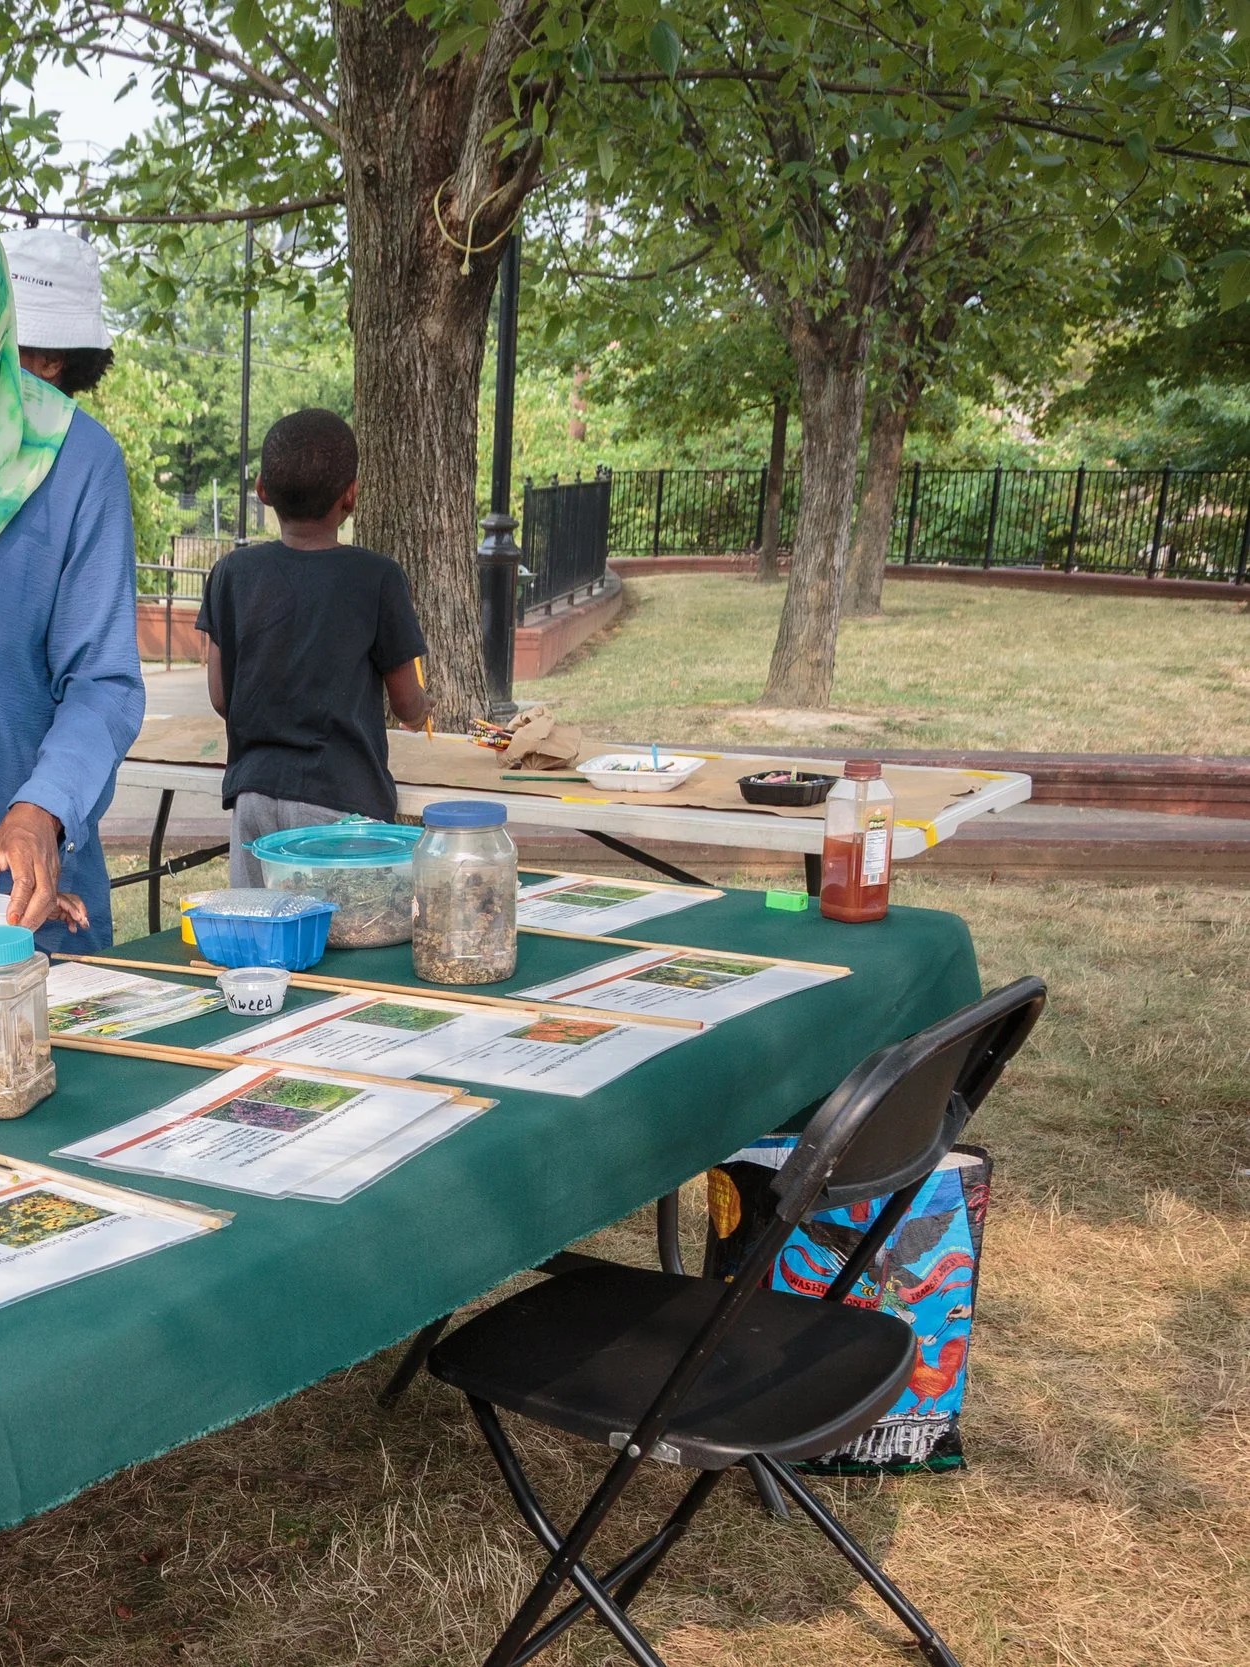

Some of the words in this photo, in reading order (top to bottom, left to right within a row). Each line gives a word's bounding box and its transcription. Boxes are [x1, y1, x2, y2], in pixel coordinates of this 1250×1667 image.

[20, 275, 53, 287] HILFIGER
[71, 1215, 131, 1238] Black-Eyed
[909, 1275, 939, 1301] TRADER
